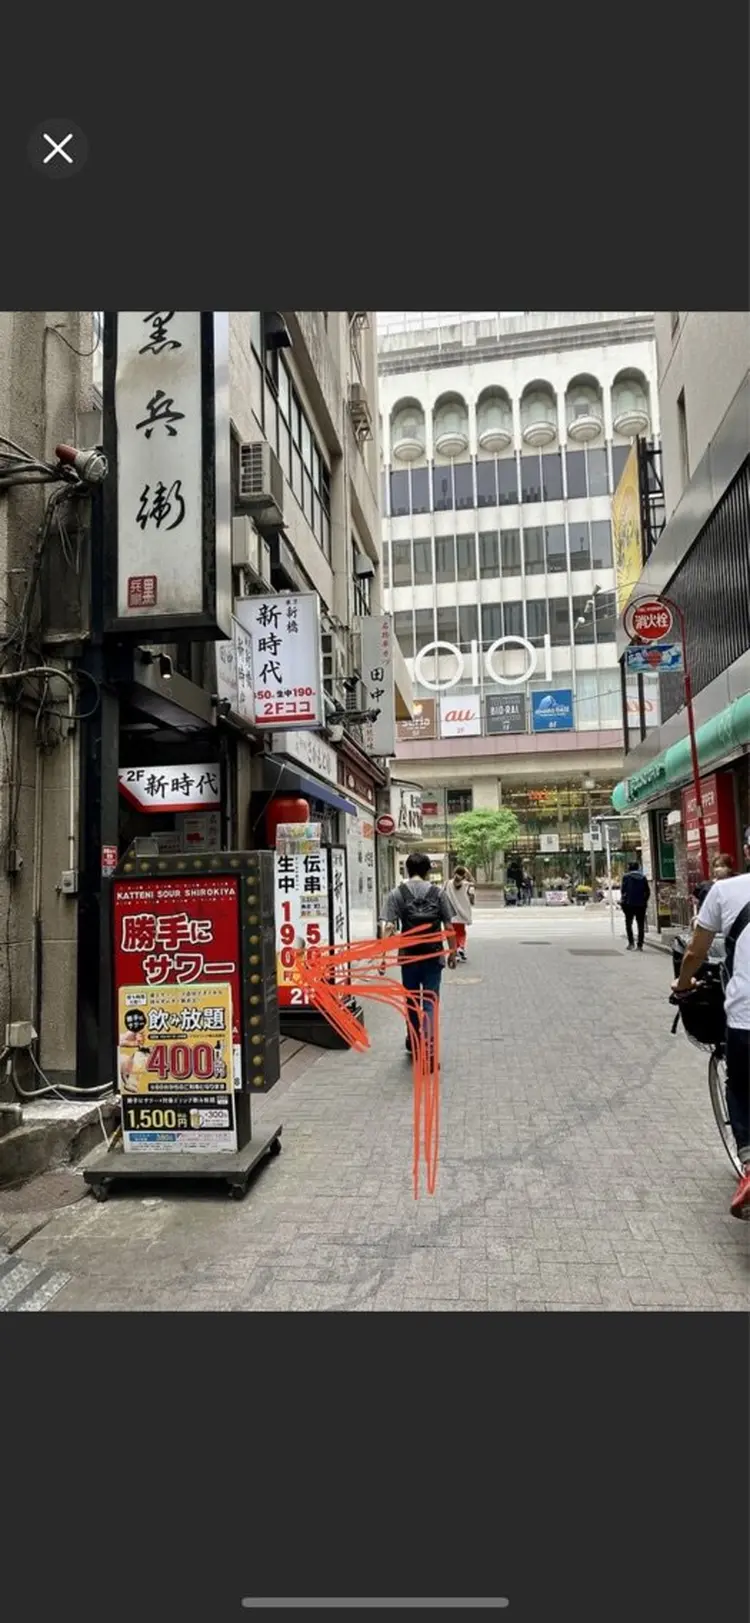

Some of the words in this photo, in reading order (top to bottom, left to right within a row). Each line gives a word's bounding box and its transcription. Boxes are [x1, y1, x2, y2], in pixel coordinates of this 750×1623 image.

[635, 613, 669, 629] 消火栓
[256, 604, 283, 685] 新時代
[370, 667, 385, 702] 田中
[264, 701, 310, 715] 2Fココ
[445, 709, 476, 722] au
[127, 770, 145, 782] 2F
[144, 772, 219, 799] 新時代
[303, 855, 321, 893] 伝串
[116, 891, 154, 900] KATTENI
[157, 889, 181, 898] SOUR
[184, 887, 235, 897] SHIROKIYA
[121, 913, 213, 952] 勝手に
[142, 953, 235, 986] サワー
[148, 1008, 226, 1032] 飲み放題
[147, 1044, 213, 1081] 400
[128, 1108, 177, 1129] 1,500
